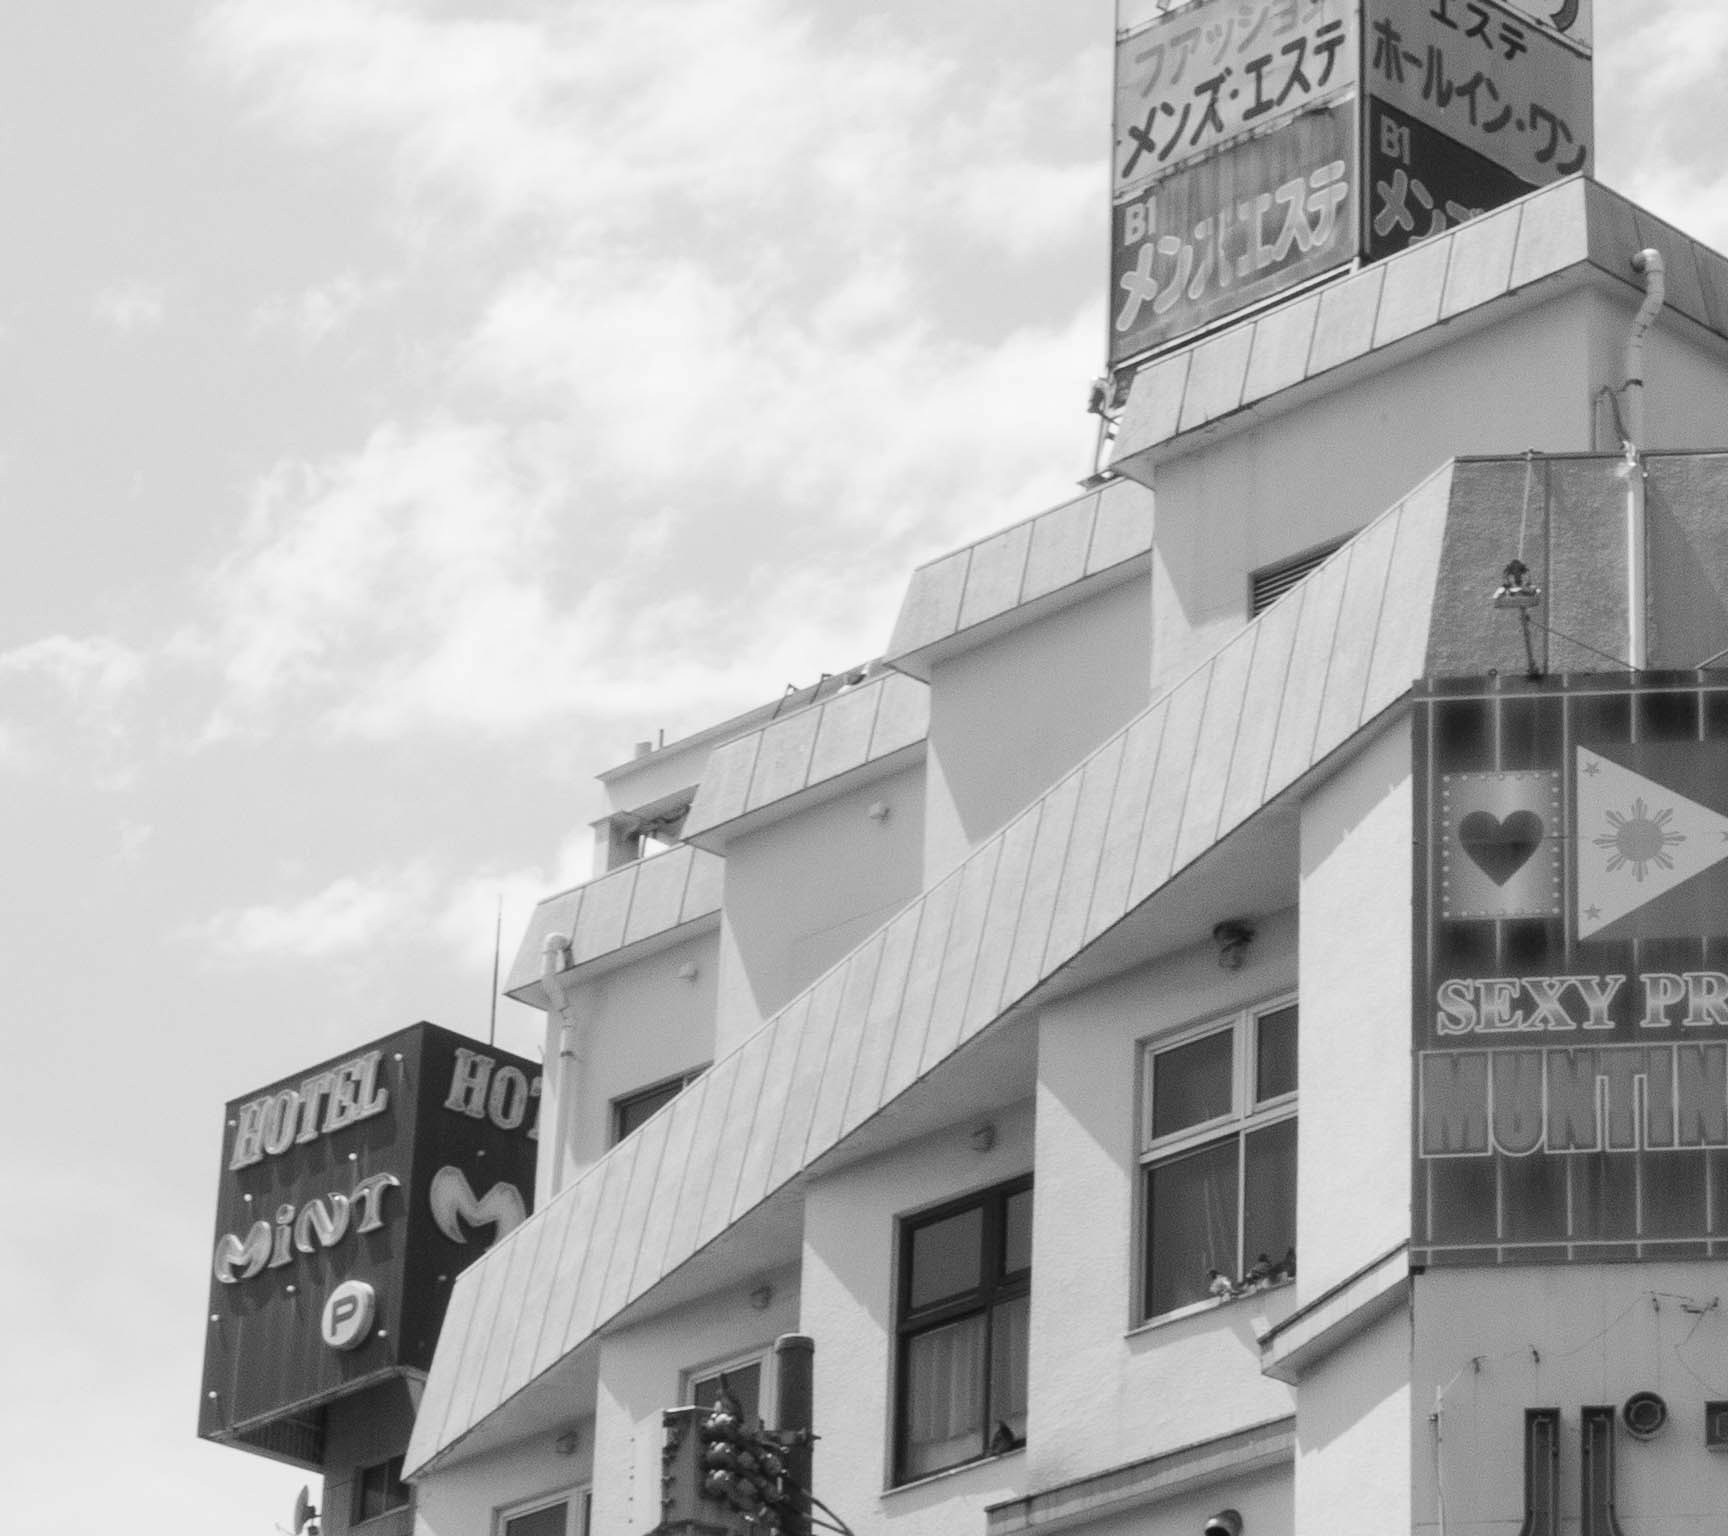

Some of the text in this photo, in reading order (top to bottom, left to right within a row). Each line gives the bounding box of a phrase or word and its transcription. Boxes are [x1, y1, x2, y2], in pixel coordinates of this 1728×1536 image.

[1121, 19, 1345, 179] メンズ・エステ
[1381, 115, 1410, 166] B1
[1124, 195, 1156, 246] B1
[1374, 169, 1484, 247] メン
[1436, 974, 1625, 1035] SEXY
[229, 1050, 387, 1170] HOTEL
